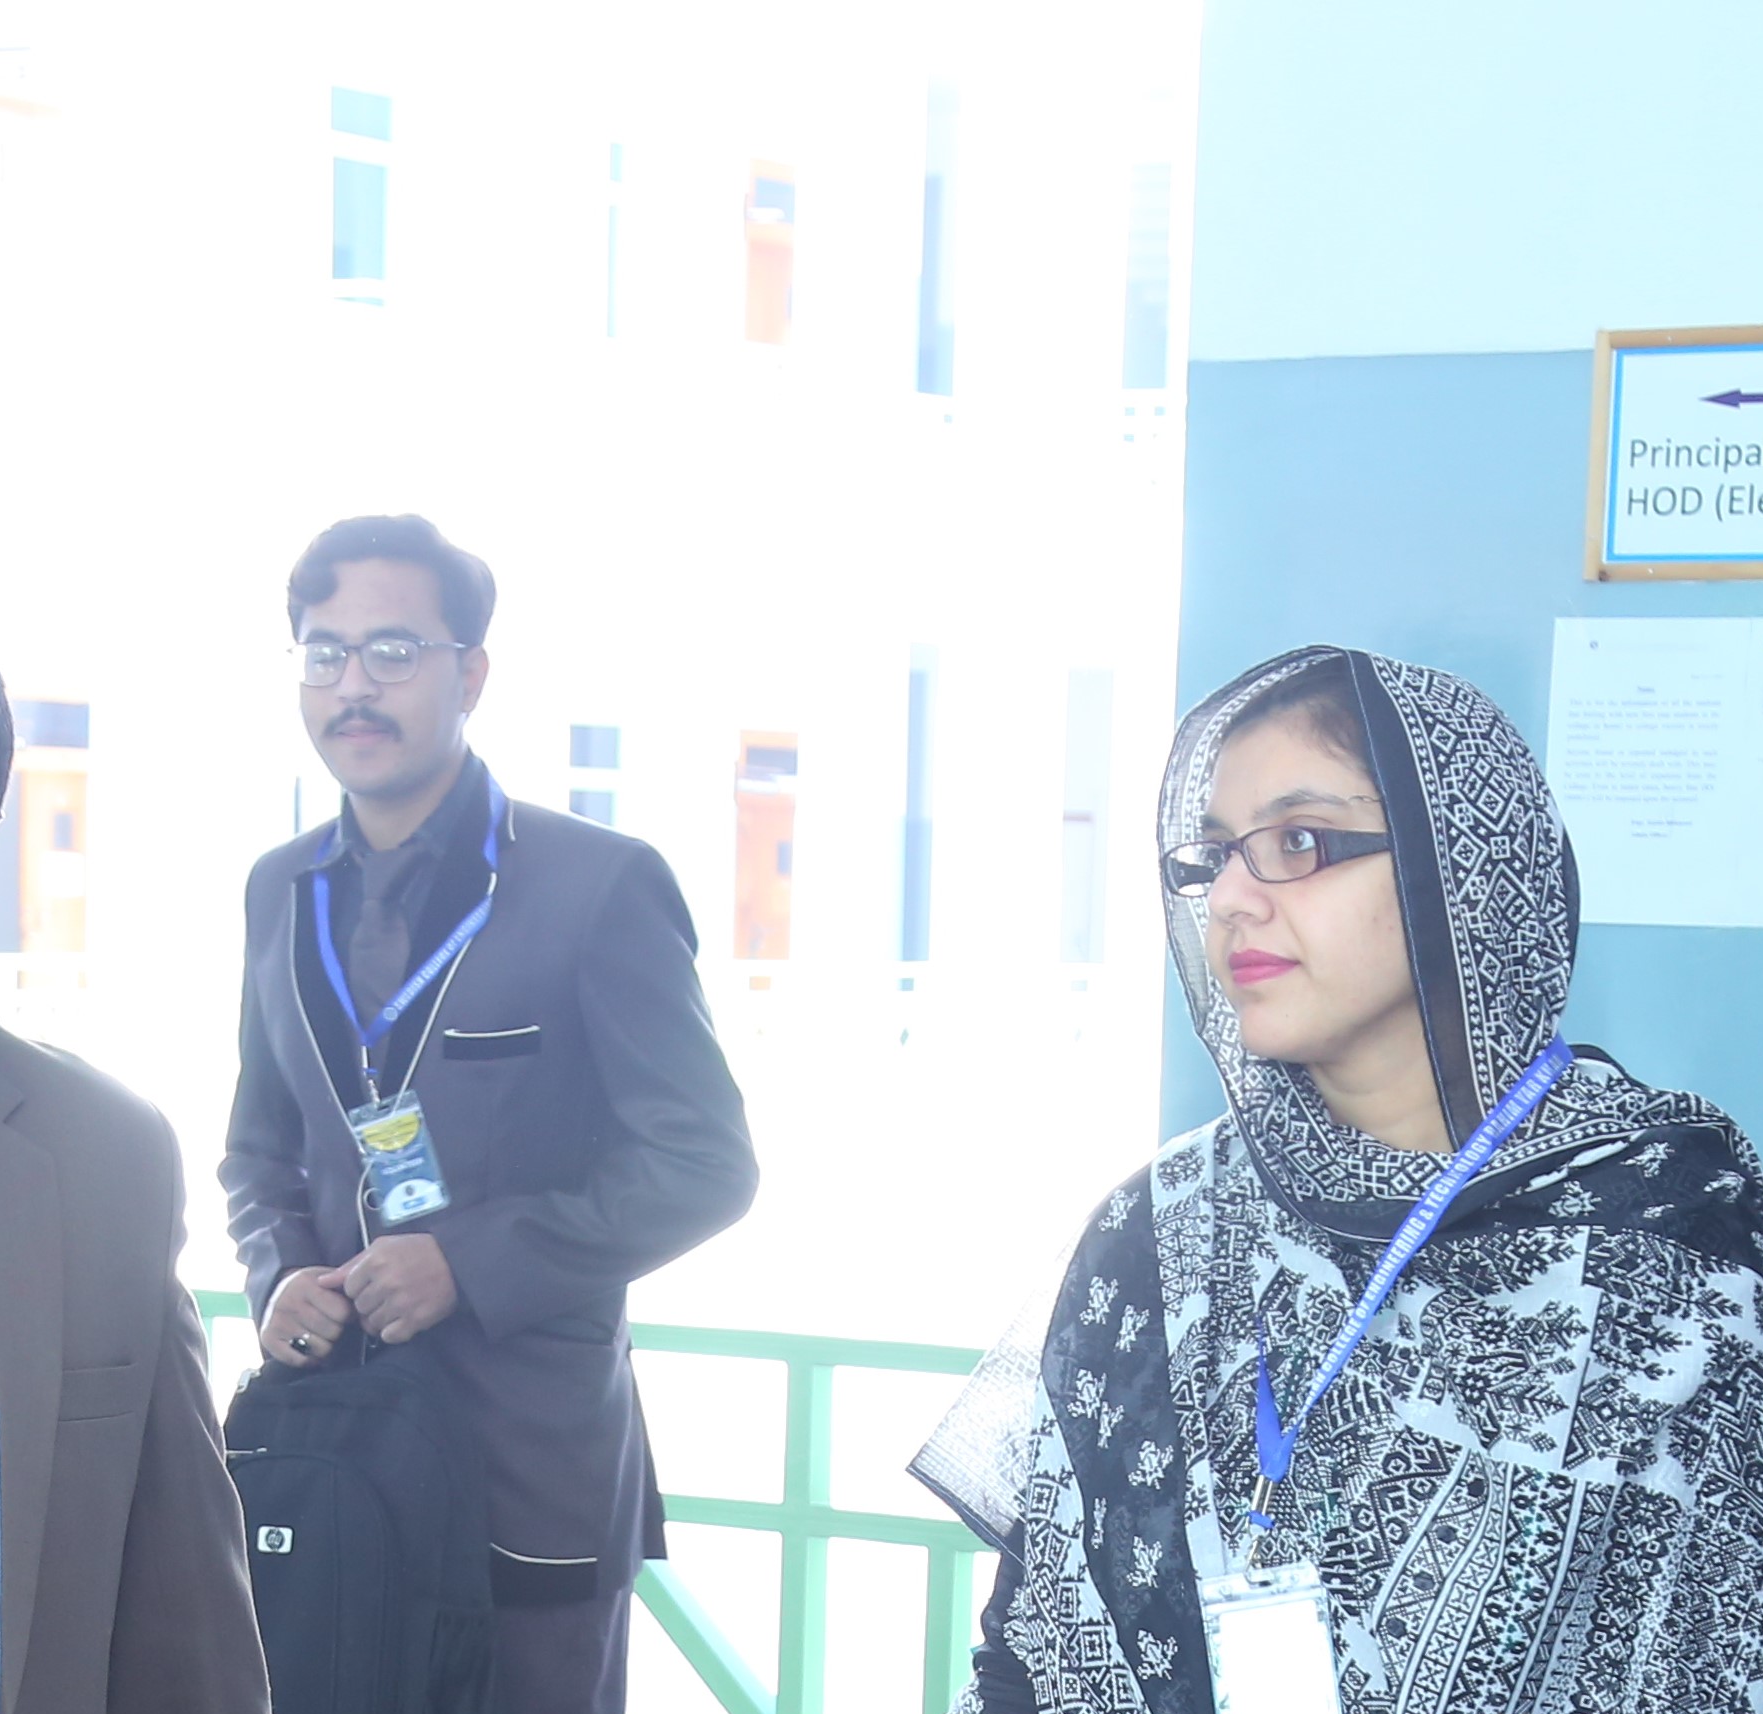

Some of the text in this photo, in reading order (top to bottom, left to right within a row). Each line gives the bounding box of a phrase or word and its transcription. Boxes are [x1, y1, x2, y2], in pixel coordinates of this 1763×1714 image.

[1626, 487, 1704, 516] HOD
[1514, 1079, 1543, 1105] YAR
[1424, 1133, 1492, 1209] TECHNOLOGY
[1419, 1208, 1434, 1220] &
[1364, 1216, 1426, 1301] ENGINEERING
[1355, 1301, 1370, 1319] OF
[1321, 1317, 1362, 1372] COLLEGE
